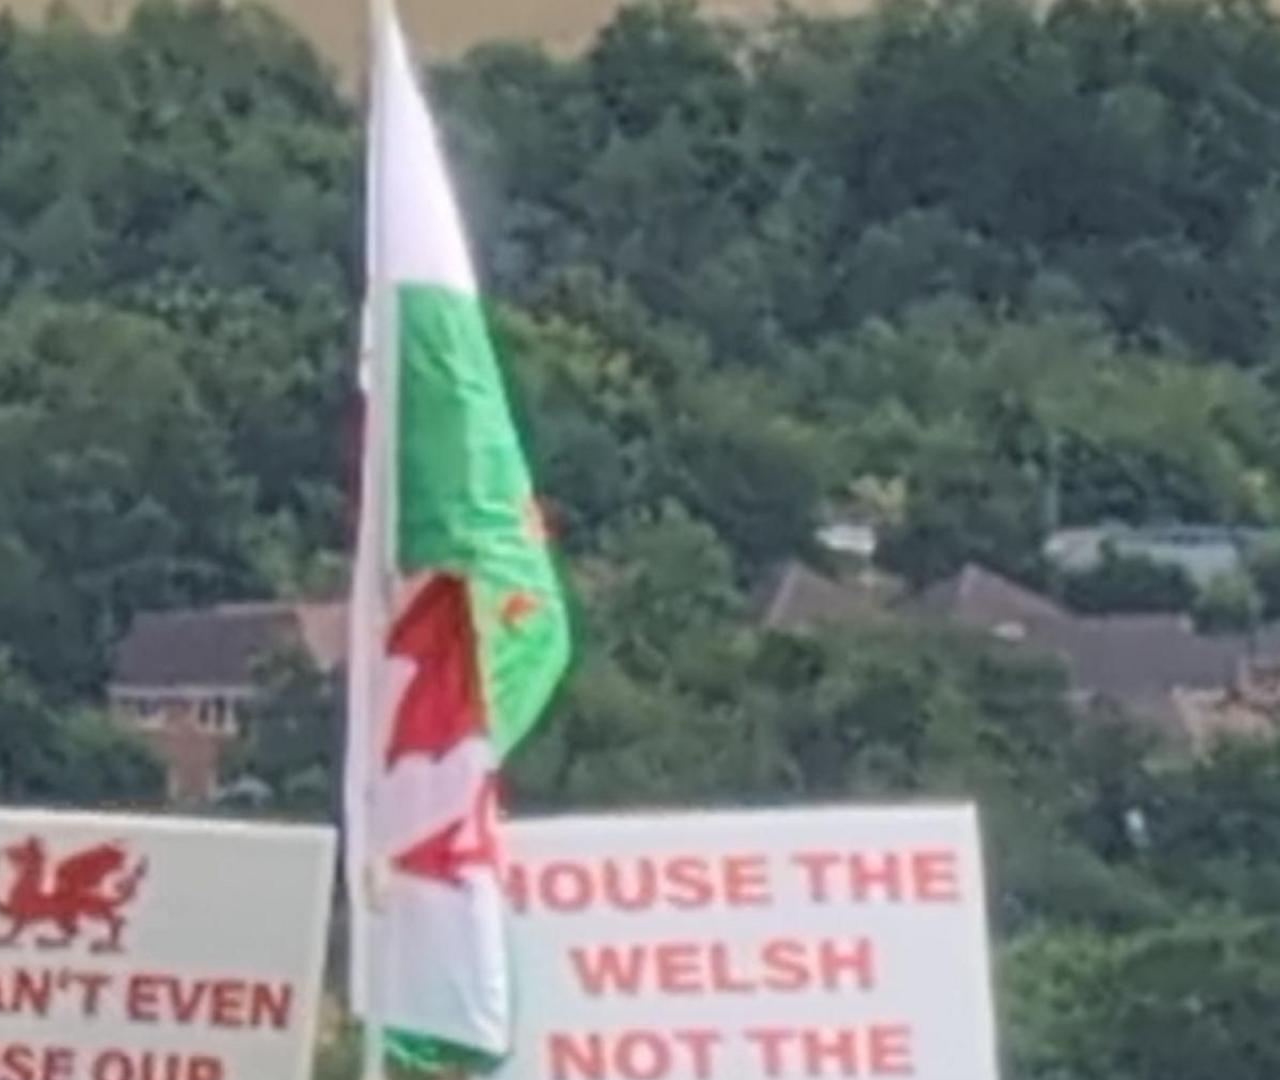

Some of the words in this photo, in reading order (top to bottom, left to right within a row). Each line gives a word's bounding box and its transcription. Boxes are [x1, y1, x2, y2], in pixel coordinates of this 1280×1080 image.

[794, 850, 961, 906] THE
[570, 938, 874, 996] WELSH
[126, 973, 293, 1029] EVEN
[746, 1025, 914, 1080] THE
